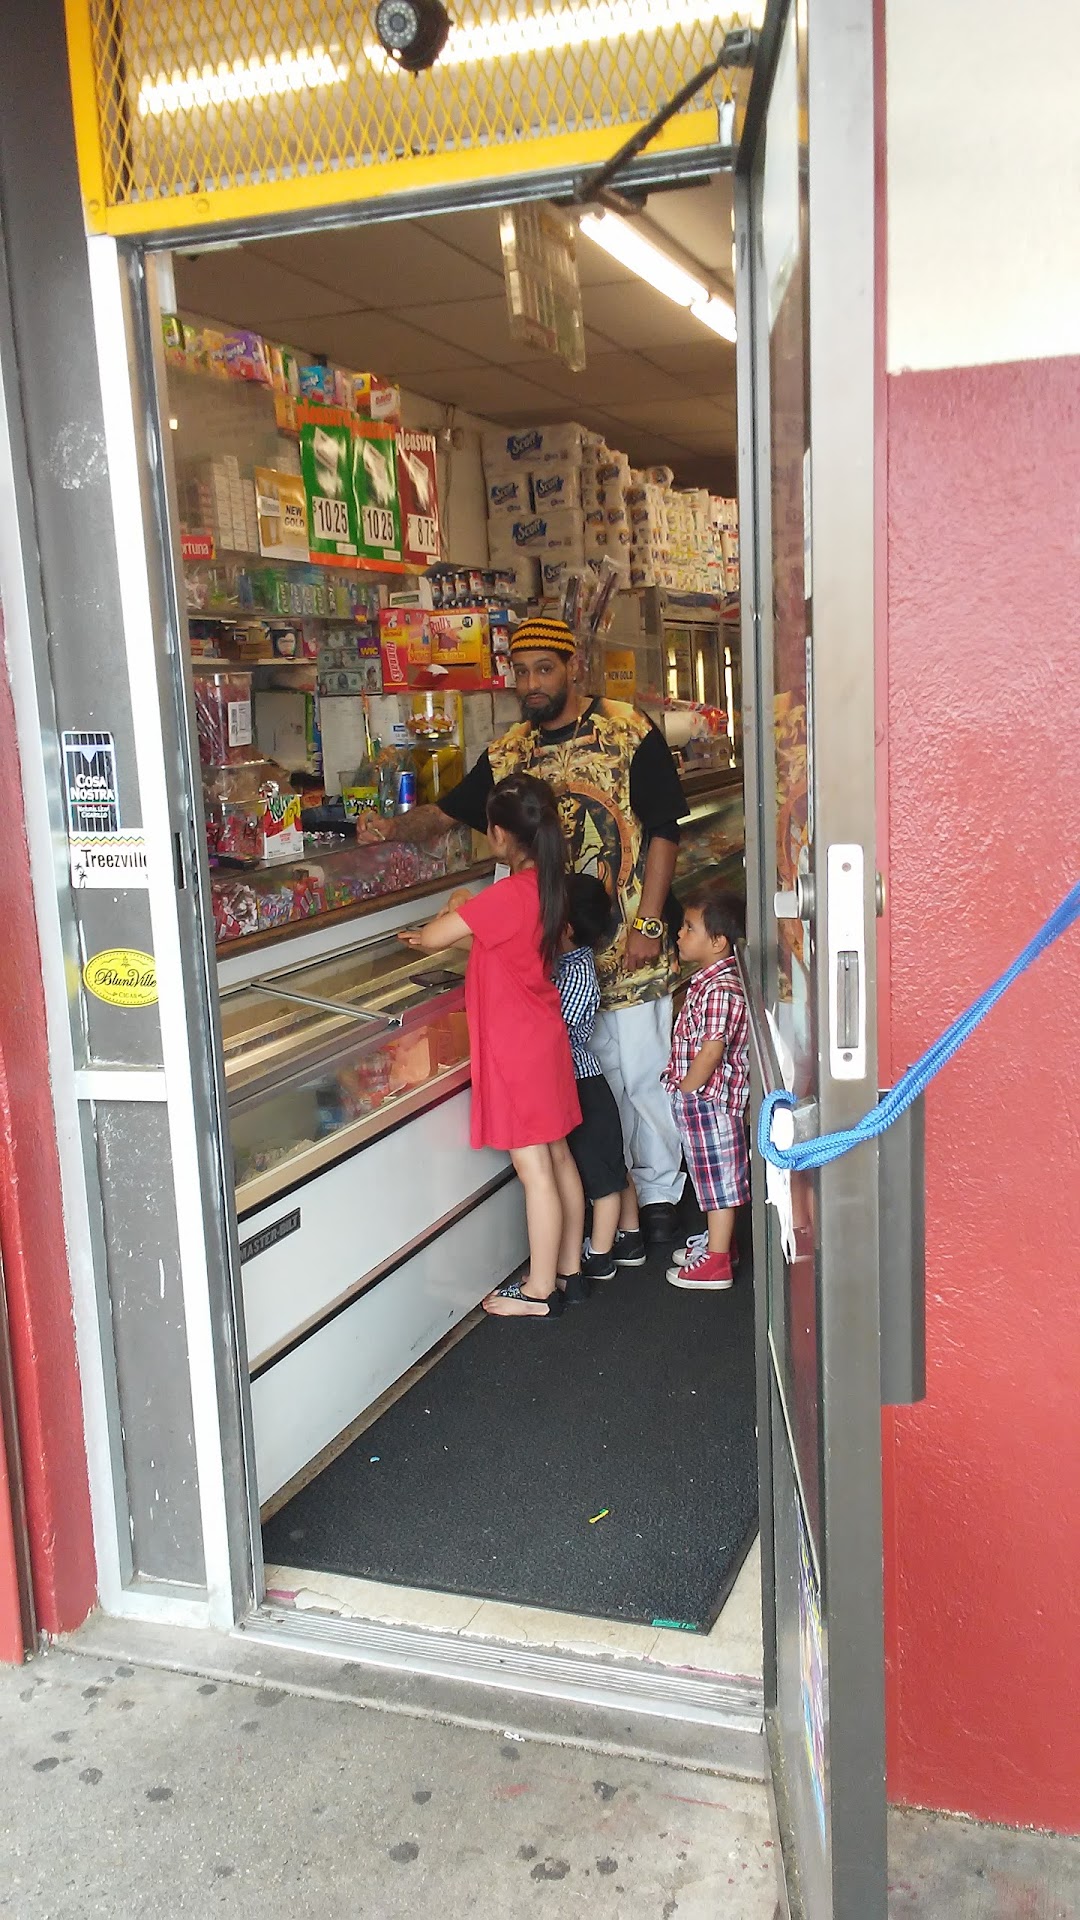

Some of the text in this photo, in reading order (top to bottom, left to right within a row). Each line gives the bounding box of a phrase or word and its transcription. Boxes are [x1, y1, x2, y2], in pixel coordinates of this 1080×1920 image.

[285, 505, 303, 518] NEW
[284, 516, 305, 528] GOLD
[517, 517, 541, 541] Scott
[76, 774, 107, 788] COSA
[70, 787, 115, 800] NOSTRA
[94, 968, 158, 988] BluntVille
